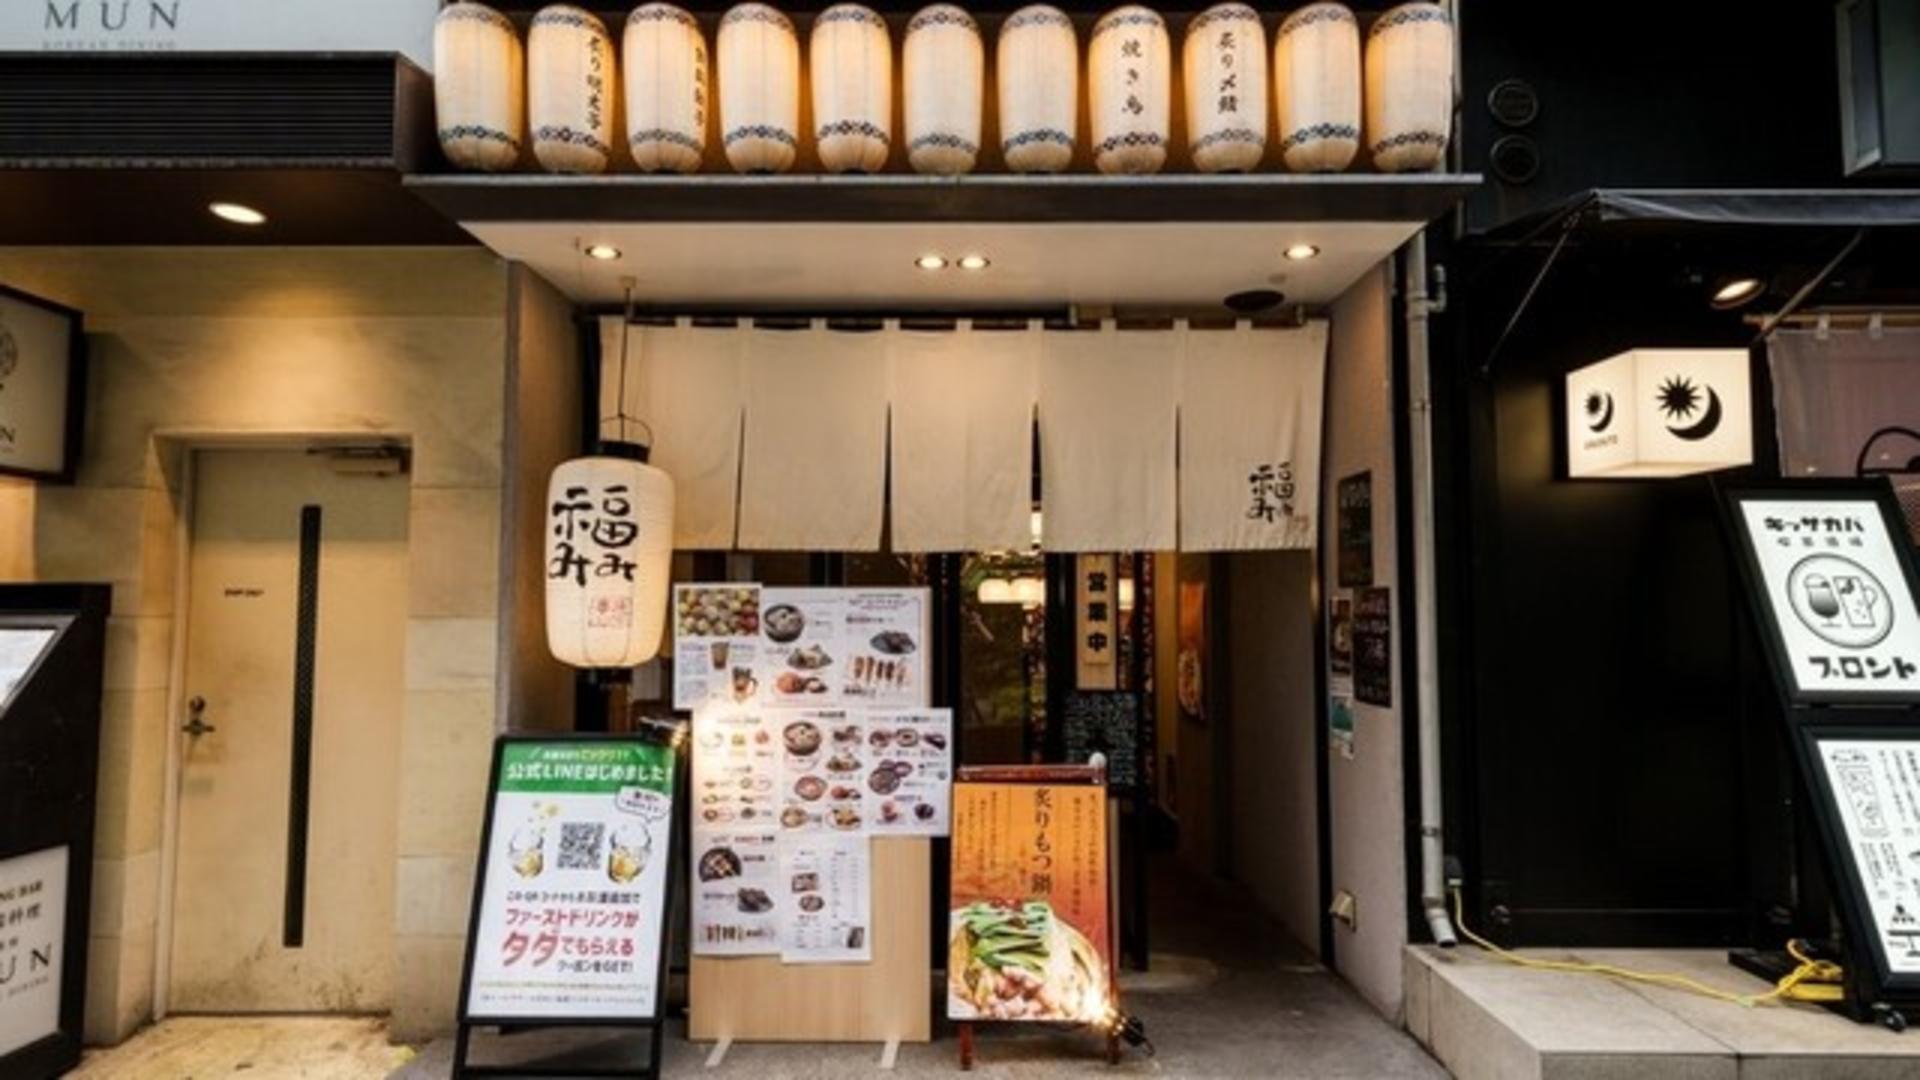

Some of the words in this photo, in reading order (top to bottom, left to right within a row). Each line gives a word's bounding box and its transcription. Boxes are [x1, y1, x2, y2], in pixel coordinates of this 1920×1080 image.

[44, 1, 179, 31] MUN
[1121, 40, 1143, 115] 焼き鳥
[1088, 572, 1108, 652] 営業中
